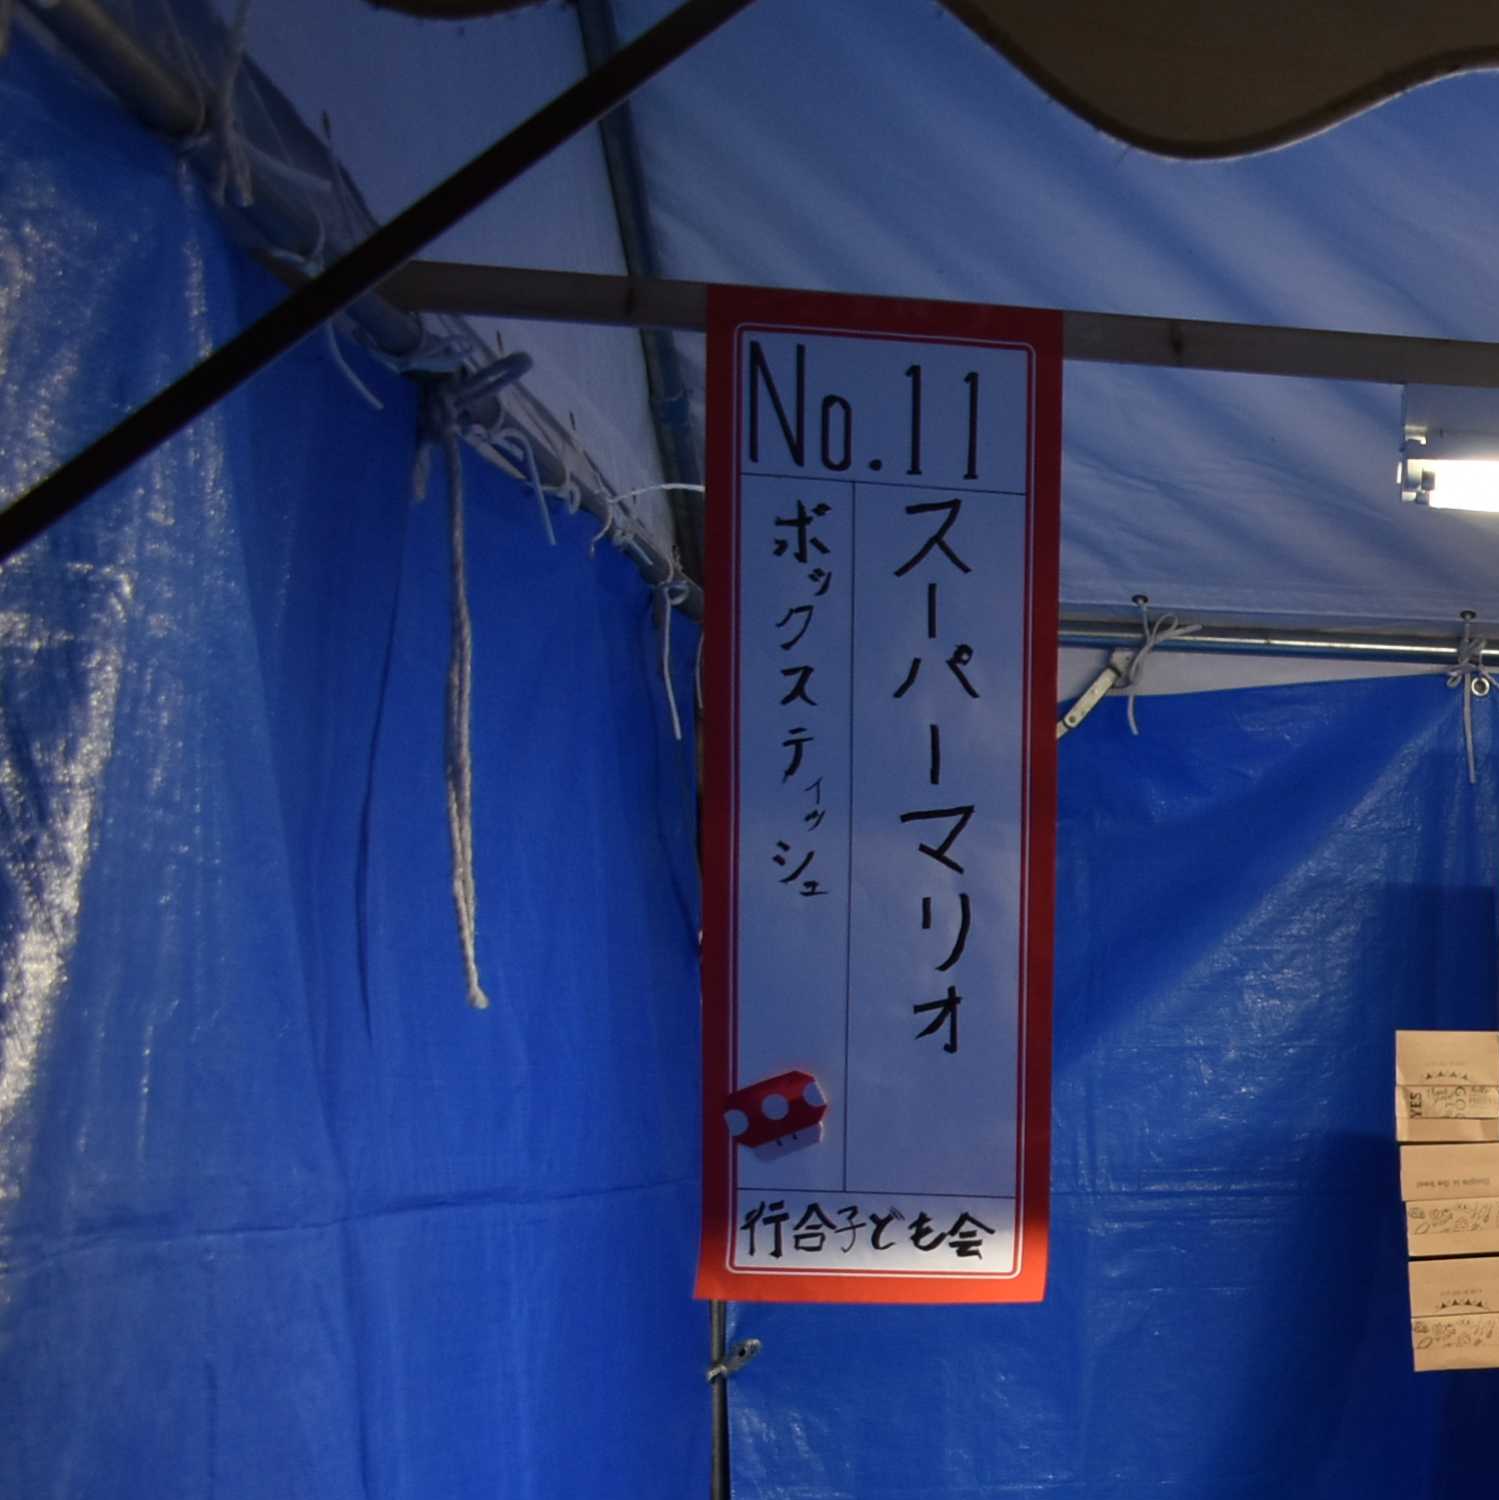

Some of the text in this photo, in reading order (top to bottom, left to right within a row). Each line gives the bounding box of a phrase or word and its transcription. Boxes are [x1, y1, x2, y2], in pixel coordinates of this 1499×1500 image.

[772, 500, 832, 898] ボックスティッシュ
[893, 498, 978, 1055] スーパーマリオ
[740, 1200, 996, 1260] 行合子ども会
